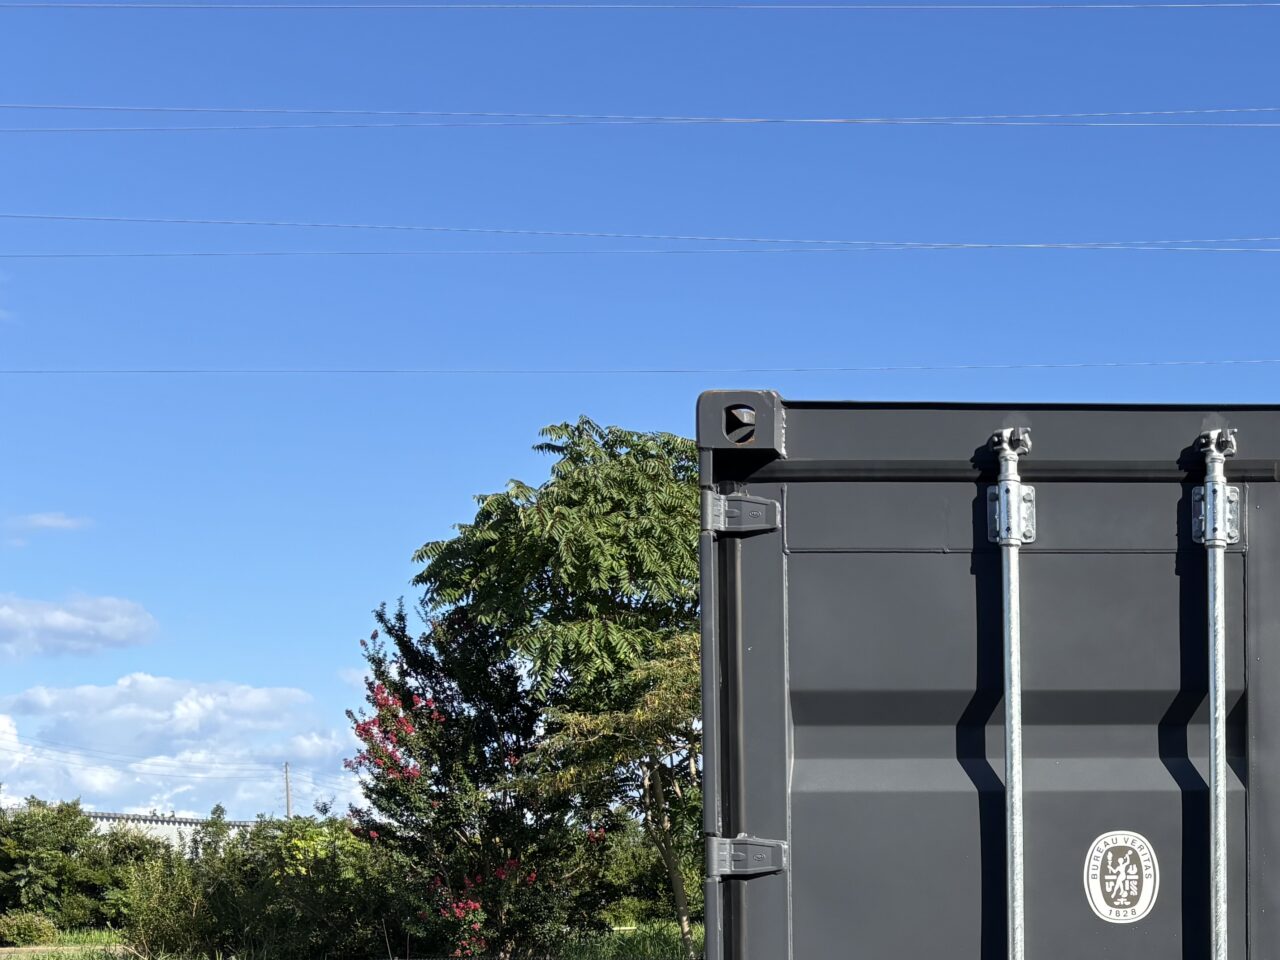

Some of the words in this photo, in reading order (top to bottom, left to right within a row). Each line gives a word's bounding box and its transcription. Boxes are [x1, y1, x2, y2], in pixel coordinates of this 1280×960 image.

[1091, 837, 1118, 880] BUREAU
[1123, 837, 1153, 880] VERITAS
[1109, 908, 1137, 918] 1828
